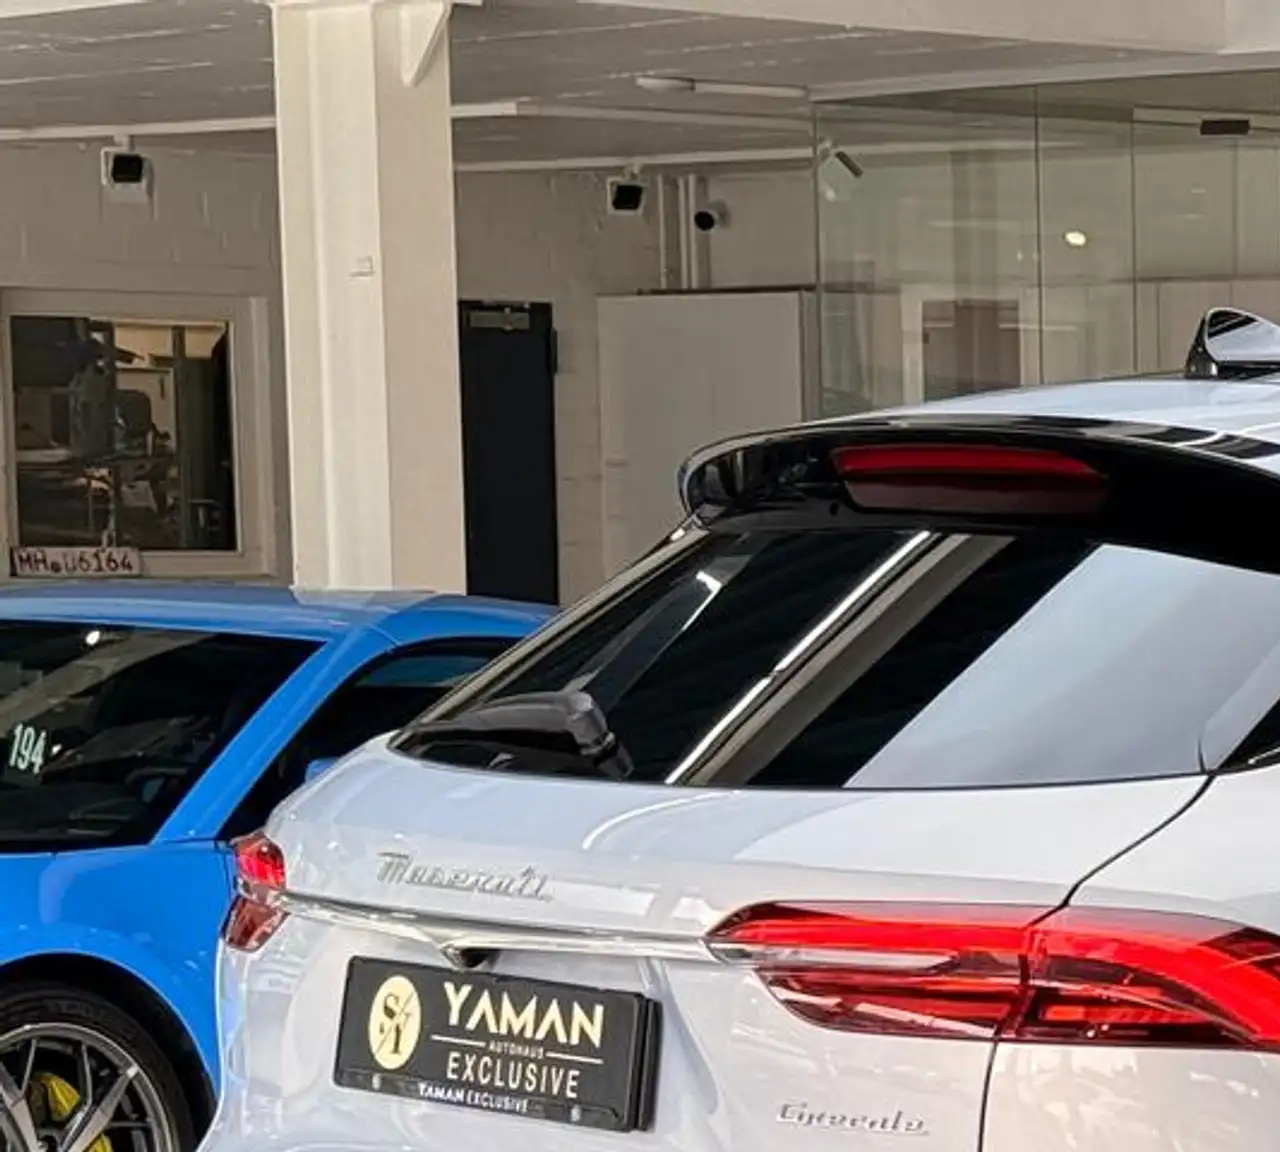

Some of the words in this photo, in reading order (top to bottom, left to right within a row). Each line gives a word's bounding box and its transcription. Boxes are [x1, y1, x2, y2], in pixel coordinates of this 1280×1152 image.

[9, 723, 47, 775] 194
[376, 851, 555, 902] Maserati
[442, 981, 605, 1049] YAMAN
[446, 1050, 582, 1099] EXCLUSIVE
[488, 1039, 545, 1060] AUTOHAUS
[417, 1081, 465, 1104] YAMAN
[465, 1089, 530, 1114] EXCLUSIVE
